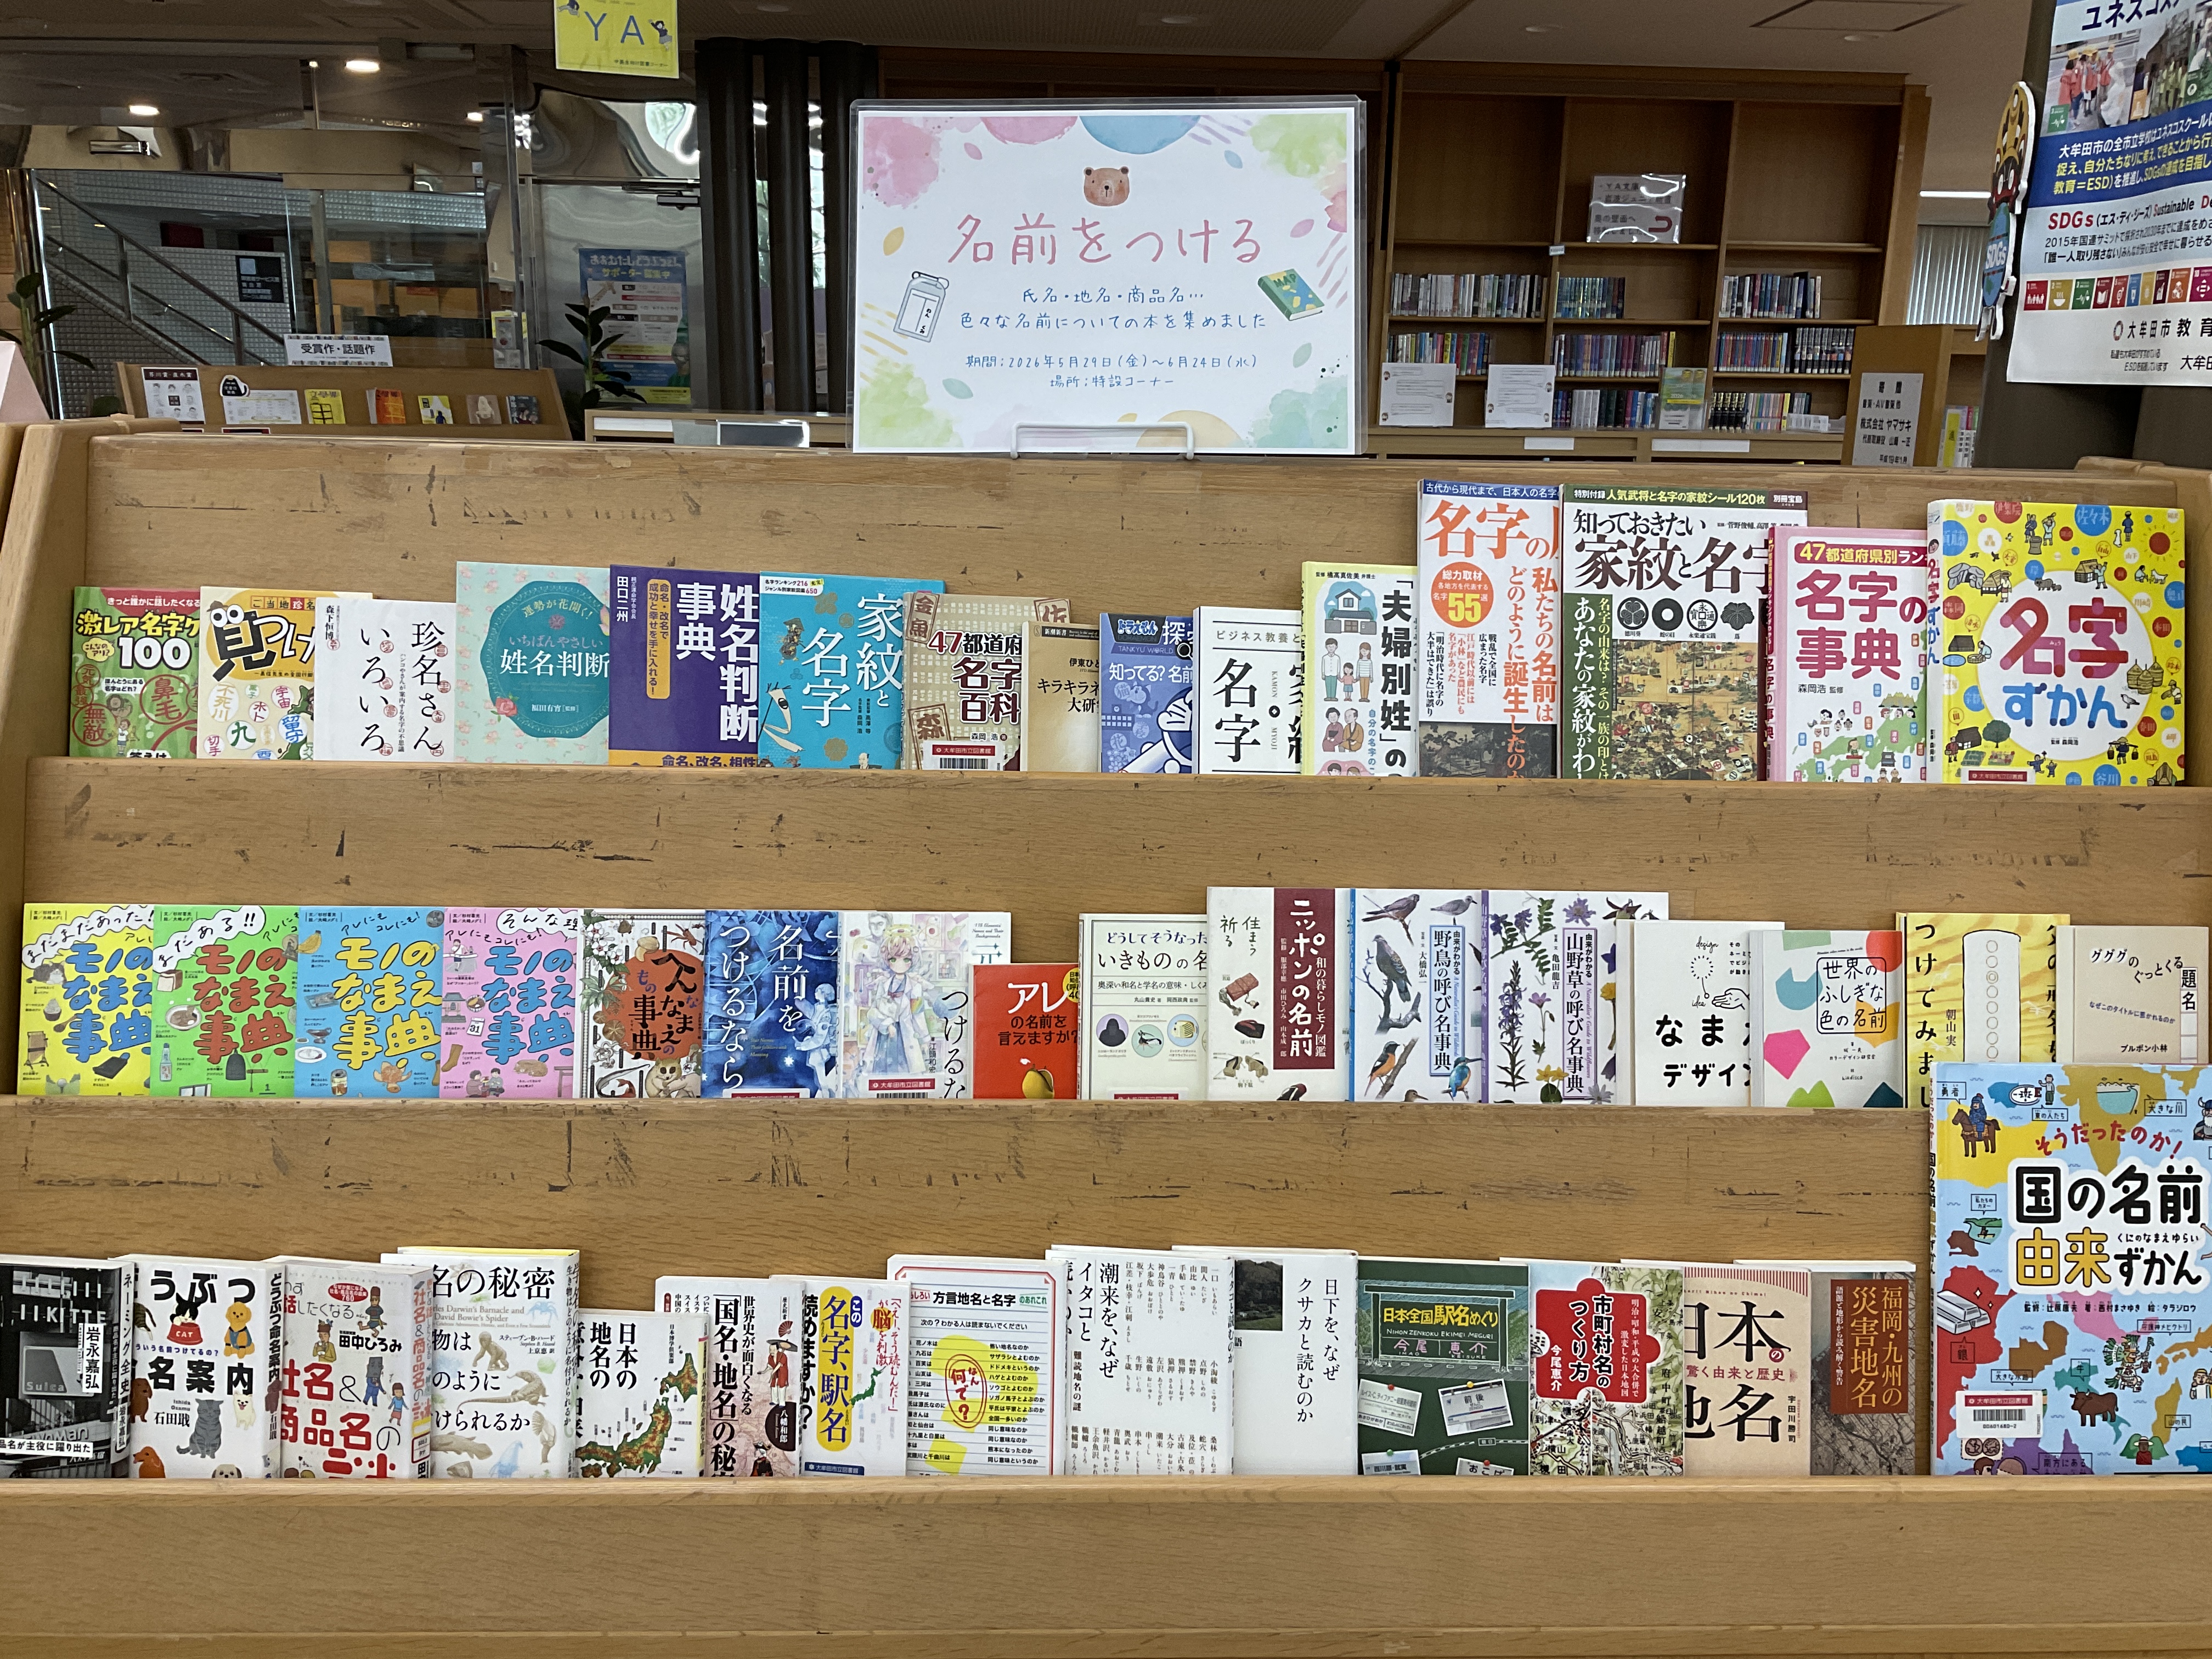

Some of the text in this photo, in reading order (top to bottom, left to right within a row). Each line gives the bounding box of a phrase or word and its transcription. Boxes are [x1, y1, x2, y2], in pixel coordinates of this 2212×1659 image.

[2049, 198, 2194, 229] SDGs Sustainable
[948, 212, 1261, 266] 名前をつける
[1985, 241, 2007, 268] SDGs
[1273, 274, 1296, 287] MAP
[960, 312, 1267, 330] 色々な名前についての本を集めました
[301, 343, 375, 355] 受賞作・話題作
[1860, 417, 1911, 431] 株式会社 ヤマサキ
[1574, 489, 1803, 505] 特別付録 人気武将と名字の家紋シール120枚 別冊宝島
[1573, 510, 1706, 536] 知っておきたい
[2078, 510, 2110, 526] 佐々木
[1438, 583, 1488, 591] 各地方を代表する
[1442, 569, 1482, 581] 総力取材
[108, 597, 200, 607] きっと誰かに話したくなる
[617, 576, 629, 622] 田口二州
[659, 583, 669, 639] 命名・改名で
[1795, 569, 1927, 623] 名字の
[648, 583, 658, 695] 成功と幸せを手に入れる!
[676, 582, 716, 661] 事典
[1045, 628, 1067, 636] 新潮新書
[2000, 597, 2128, 679] 名字
[119, 637, 190, 669] 100
[510, 635, 602, 648] いちばんやさしい
[856, 593, 903, 707] 家紋と
[1479, 634, 1487, 684] 広まった名字
[1532, 567, 1557, 722] 私たちの名前は
[1598, 598, 1610, 684] 名字の由来は?
[1796, 627, 1901, 680] 事典
[500, 649, 610, 678] 姓名判断
[720, 583, 759, 743] 姓名判断
[802, 627, 851, 727] 名字
[952, 657, 1022, 691] 名字
[1110, 663, 1165, 681] 知ってる?
[1466, 633, 1475, 704] 江戸時代以前には
[1488, 634, 1497, 686] 戦乱で全国に
[151, 678, 182, 720] 鼻毛
[275, 686, 291, 708] 宇宙
[359, 628, 389, 751] いろいろ
[411, 621, 445, 751] 珍名さん
[1798, 684, 1826, 693] 森岡浩
[958, 692, 1022, 724] 百科
[1213, 658, 1260, 762] 名字
[2002, 682, 2128, 729] ずかん
[82, 707, 107, 741] 無敵
[231, 722, 256, 746] 九
[282, 716, 305, 743] 留守
[207, 736, 221, 757] 切手
[2096, 773, 2119, 786] 谷川
[1220, 916, 1238, 947] 祈る
[1242, 916, 1261, 956] 住まう
[1696, 936, 1719, 953] design
[65, 943, 152, 973] モノの
[196, 944, 287, 974] モノの
[335, 938, 437, 970] モノの
[484, 946, 573, 975] モノの
[1418, 951, 1427, 984] 大橋弘一
[1552, 954, 1560, 990] 亀田龍吉
[1823, 958, 1877, 980] 世界の
[63, 974, 152, 1012] なまえ
[193, 975, 295, 1013] なまえ
[332, 971, 441, 1013] なまえ
[482, 977, 575, 1013] なまえ
[769, 924, 810, 1032] 名前を
[1288, 900, 1326, 1058] ニッポンの名前
[1820, 983, 1884, 1003] ふしぎな
[2181, 969, 2197, 1011] 題名
[720, 926, 750, 1090] つけるなら
[1008, 982, 1068, 1014] アレ
[1315, 957, 1327, 1058] 和の暮らしモノ図鑑
[1434, 930, 1452, 1071] 野鳥の呼び名事典
[1567, 933, 1584, 1093] 山野草の呼び名事典
[1691, 996, 1706, 1007] idea
[63, 1009, 151, 1063] 事典
[193, 1010, 294, 1064] 事典
[470, 1025, 480, 1034] 31
[1011, 1015, 1067, 1029] の名前を
[1820, 1008, 1885, 1031] 色の名前
[1945, 1009, 1956, 1046] 朝山実
[332, 1010, 441, 1070] 事典
[482, 1011, 574, 1065] 事典
[998, 1030, 1078, 1046] 言えますか?
[2121, 1043, 2168, 1053] ブルボン小林
[1941, 1087, 1959, 1097] 勇者
[2148, 1104, 2183, 1114] 大きな川
[2035, 1121, 2183, 1159] そうだったのか!
[2016, 1165, 2203, 1224] 国の名前
[2118, 1233, 2199, 1243] くにのなまえゆらい
[1137, 1263, 1144, 1278] 坂下
[2016, 1227, 2111, 1287] 由来
[2114, 1248, 2202, 1286] ずかん
[447, 1305, 478, 1313] Darwin's
[479, 1306, 508, 1314] Barnacle
[851, 1299, 862, 1323] この
[933, 1290, 1047, 1307] 方言地名と名字 のあれこれ
[1078, 1262, 1095, 1342] イタコと
[1383, 1305, 1498, 1328] 日本全国駅名めぐり
[120, 1273, 132, 1395] ネーミング全史
[268, 1273, 281, 1383] どうぶつ命名案内
[435, 1313, 508, 1323] David Bowie's Spider
[921, 1319, 1028, 1330] 次の?わかる人は読まないでください
[1098, 1262, 1120, 1379] 潮来を、なぜ
[1323, 1278, 1340, 1382] 日下を、なぜ
[86, 1327, 101, 1389] 岩永嘉弘
[340, 1335, 402, 1352] 田中ひろみ
[589, 1322, 612, 1389] 地名の
[616, 1322, 639, 1390] 日本の
[741, 1295, 756, 1416] 世界史が面白くなる
[1296, 1278, 1314, 1424] クサカと読むのか
[1570, 1299, 1590, 1381] つくり方
[1593, 1295, 1614, 1388] 市町村名の
[1850, 1285, 1879, 1408] 災害地名
[1881, 1285, 1903, 1407] 福岡・九州の
[1957, 1349, 1968, 1361] 銀
[820, 1295, 850, 1443] 名字、駅名
[1073, 1351, 1082, 1412] 難読地名の謎
[1550, 1345, 1562, 1392] 今尾恵介
[1686, 1365, 1786, 1382] 驚く由来と歴史
[2076, 1364, 2084, 1373] 牛
[1464, 1393, 1485, 1404] 前後
[780, 1409, 788, 1443] 八幡和郎
